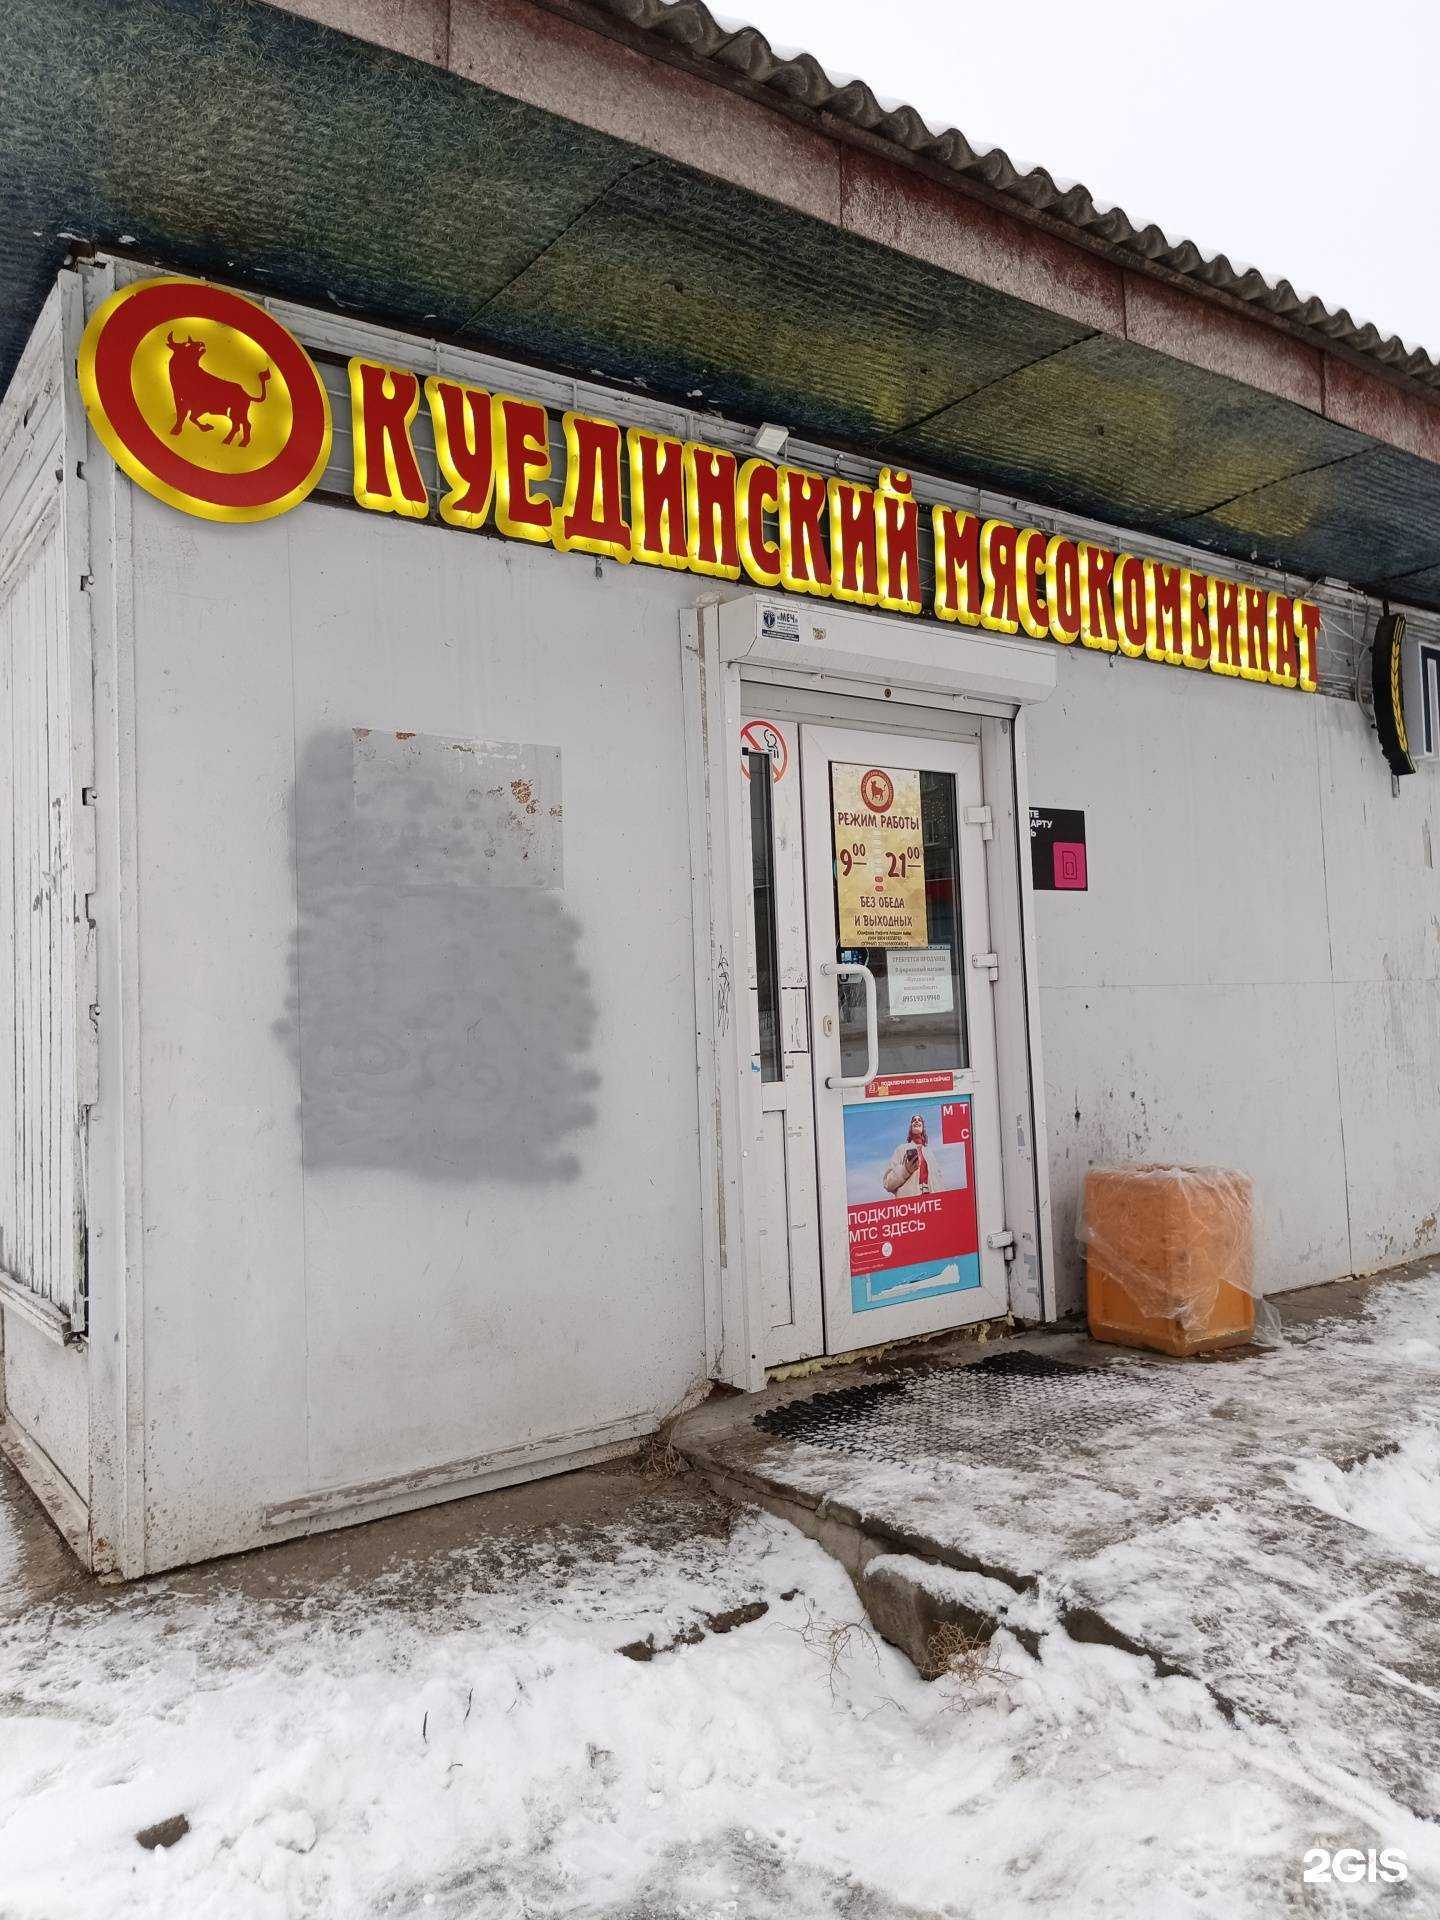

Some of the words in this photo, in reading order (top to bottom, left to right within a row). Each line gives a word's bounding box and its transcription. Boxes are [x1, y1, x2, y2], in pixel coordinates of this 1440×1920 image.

[349, 356, 922, 614] КУЕДИНСКИЙ
[932, 503, 1321, 693] МЯСОКОМБИНАТ
[838, 812, 877, 828] РЕЖИМ
[881, 817, 920, 830] РАБОТЫ
[860, 896, 876, 908] БЕЗ
[879, 897, 905, 909] ОБЕДА
[855, 915, 861, 927] И
[863, 915, 913, 927] ВЫХОДНЫХ
[848, 1199, 942, 1226] ПОДКЛЮЧИТЕ
[849, 1227, 878, 1244] МТС
[882, 1219, 926, 1238] ЗДЕСЬ
